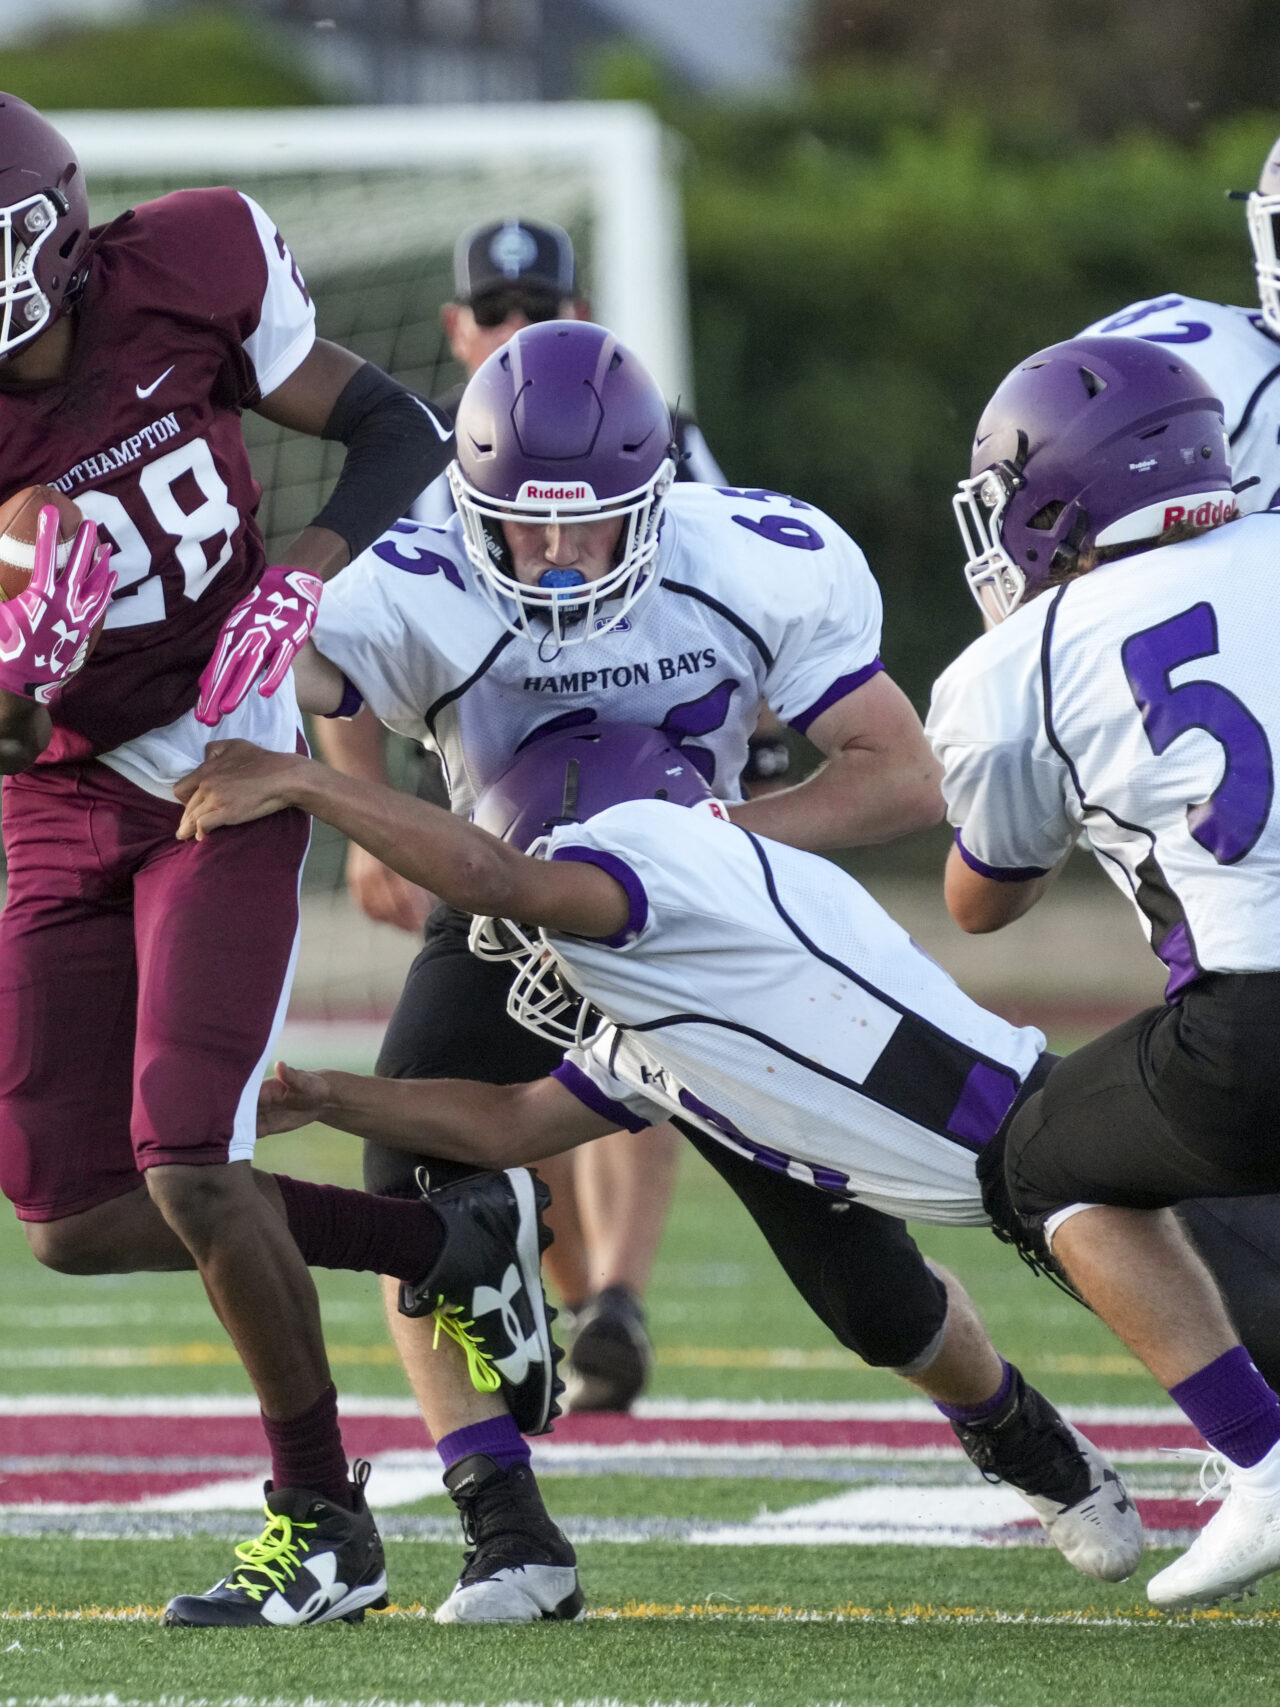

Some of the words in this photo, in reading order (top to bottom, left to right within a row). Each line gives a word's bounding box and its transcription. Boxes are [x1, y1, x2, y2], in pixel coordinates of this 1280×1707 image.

[46, 411, 182, 495] OUTHAMPTON
[526, 485, 586, 500] Riddell
[72, 436, 241, 632] 28
[523, 662, 650, 693] HAMPTON
[659, 648, 717, 681] BAYS
[1120, 601, 1275, 866] 5
